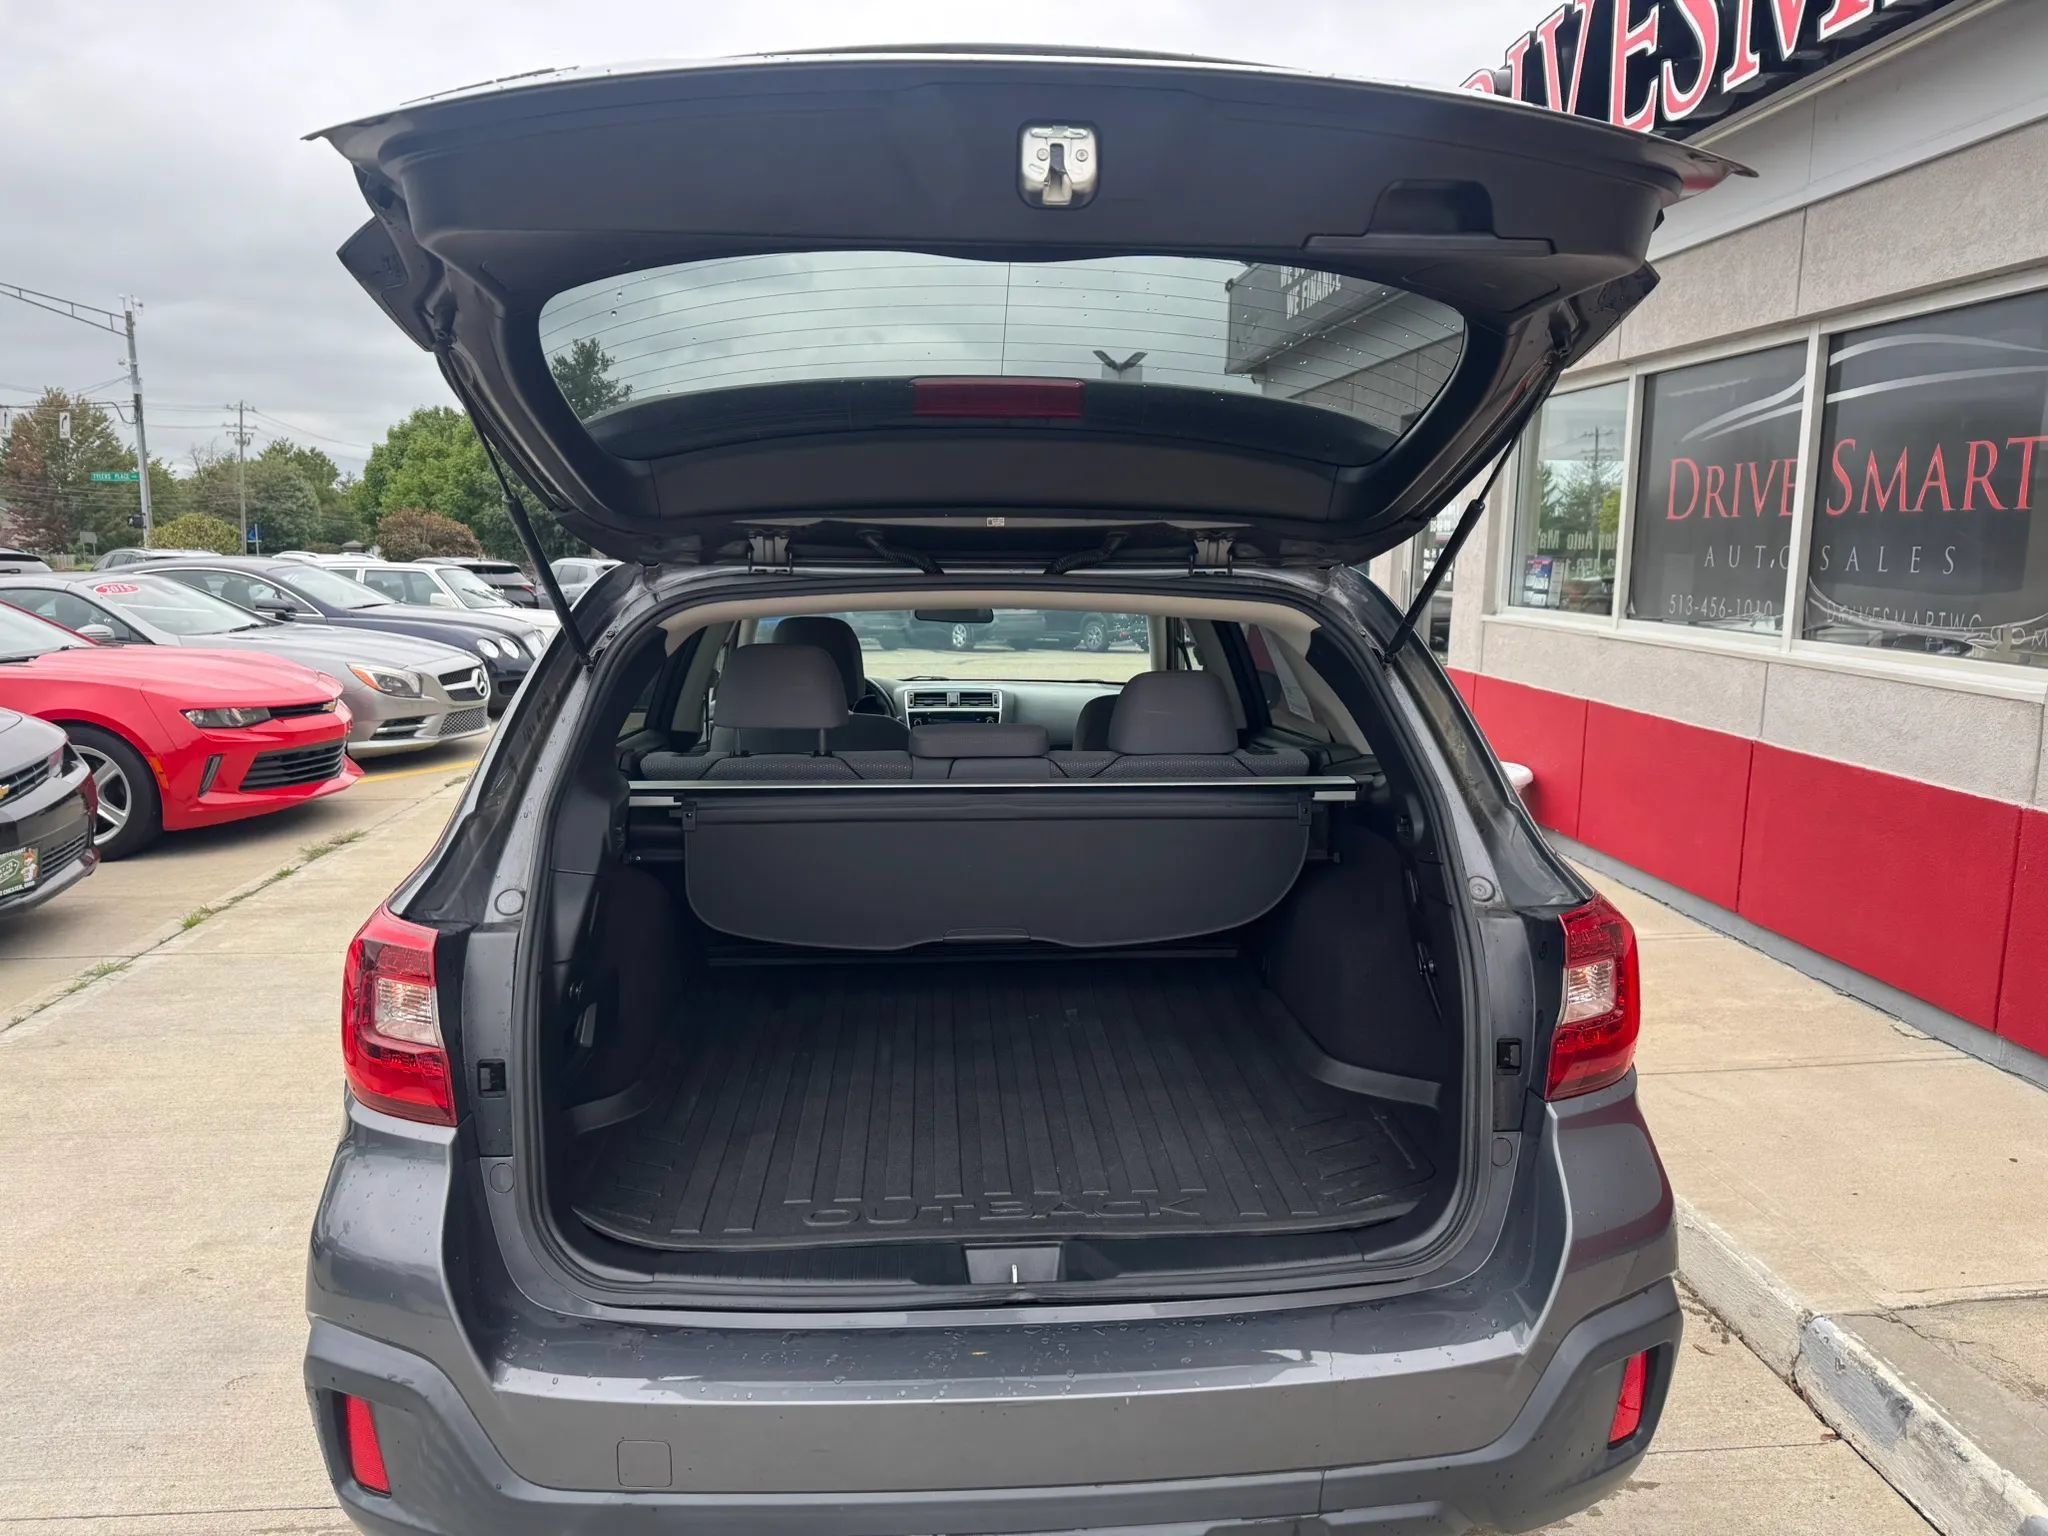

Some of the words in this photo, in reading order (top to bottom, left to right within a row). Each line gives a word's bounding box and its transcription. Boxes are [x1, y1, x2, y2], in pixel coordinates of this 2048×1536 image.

[1301, 271, 1341, 311] FINANCE
[1826, 435, 2048, 516] SMART
[1820, 545, 1956, 575] SALES
[1669, 594, 1773, 618] 513-456-1010
[802, 1196, 1201, 1227] OUTBACK
